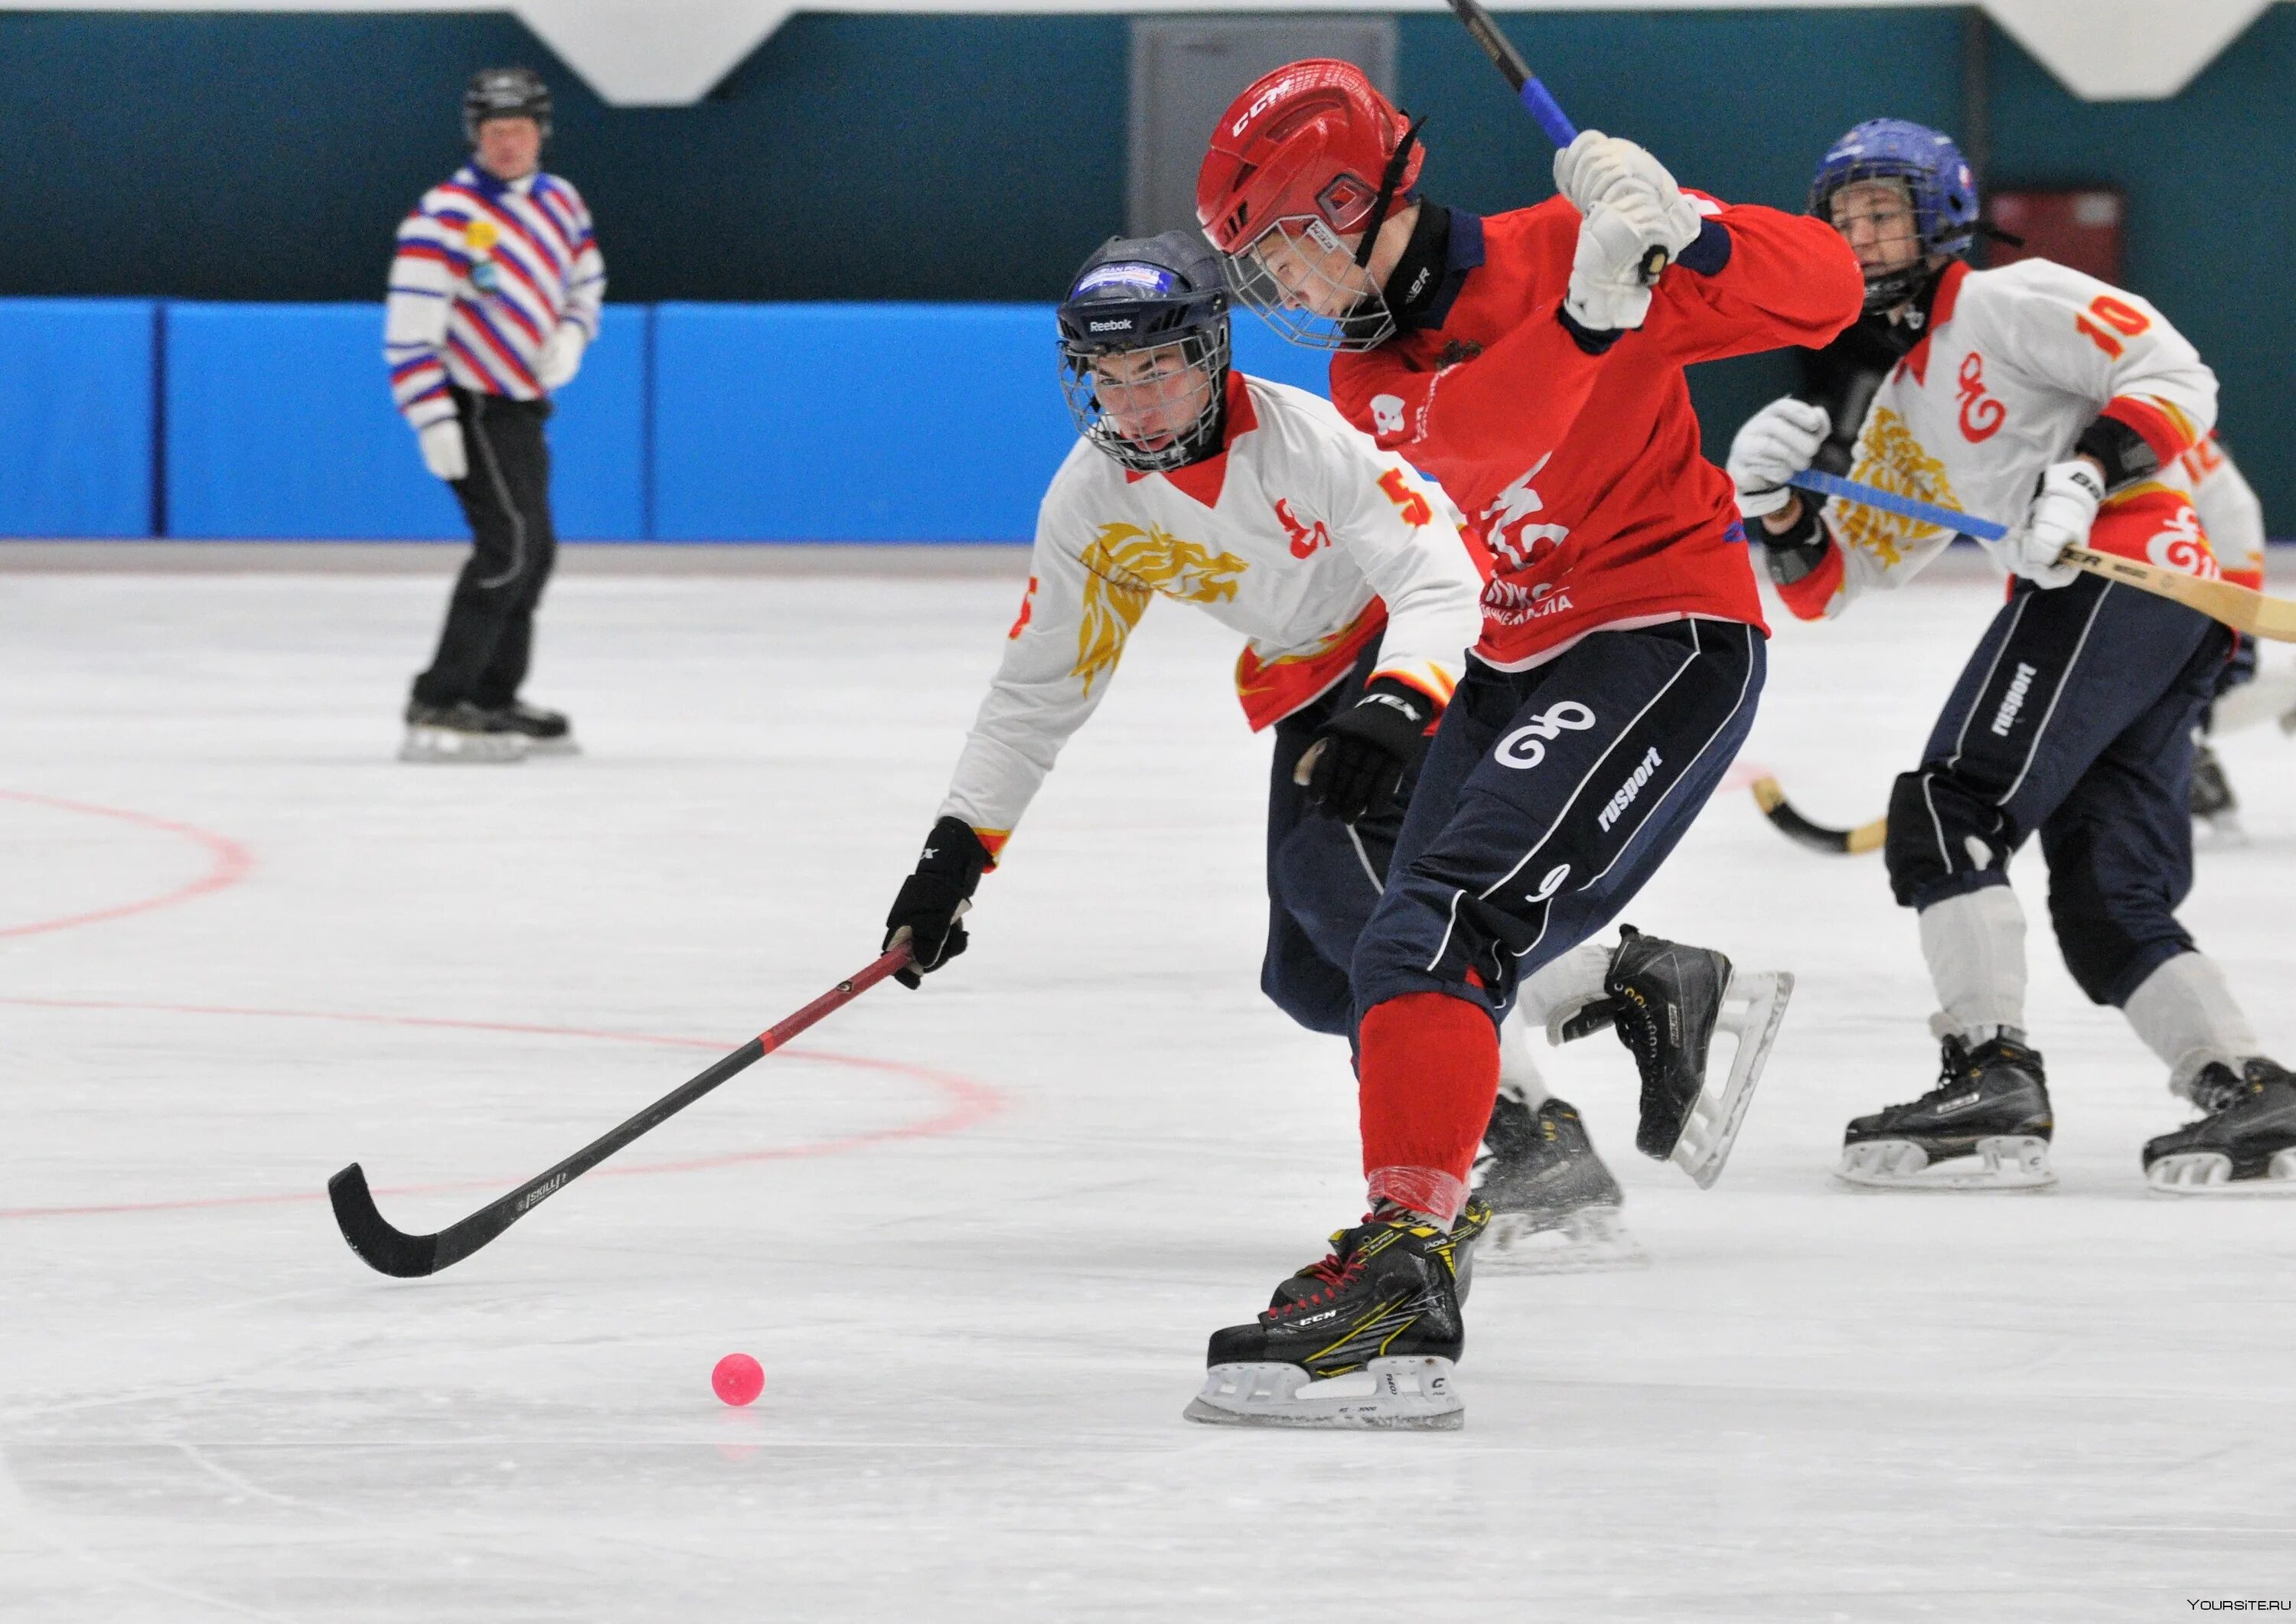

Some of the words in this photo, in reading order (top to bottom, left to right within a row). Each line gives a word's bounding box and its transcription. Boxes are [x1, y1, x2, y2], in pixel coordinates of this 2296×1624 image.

[1233, 79, 1291, 137] CCM
[1090, 318, 1133, 332] Reebok
[2075, 295, 2151, 360] 10
[1377, 467, 1433, 527] 5
[1991, 662, 2037, 736] rusport
[1597, 746, 1663, 833] rusport
[1300, 1309, 1337, 1326] CCM
